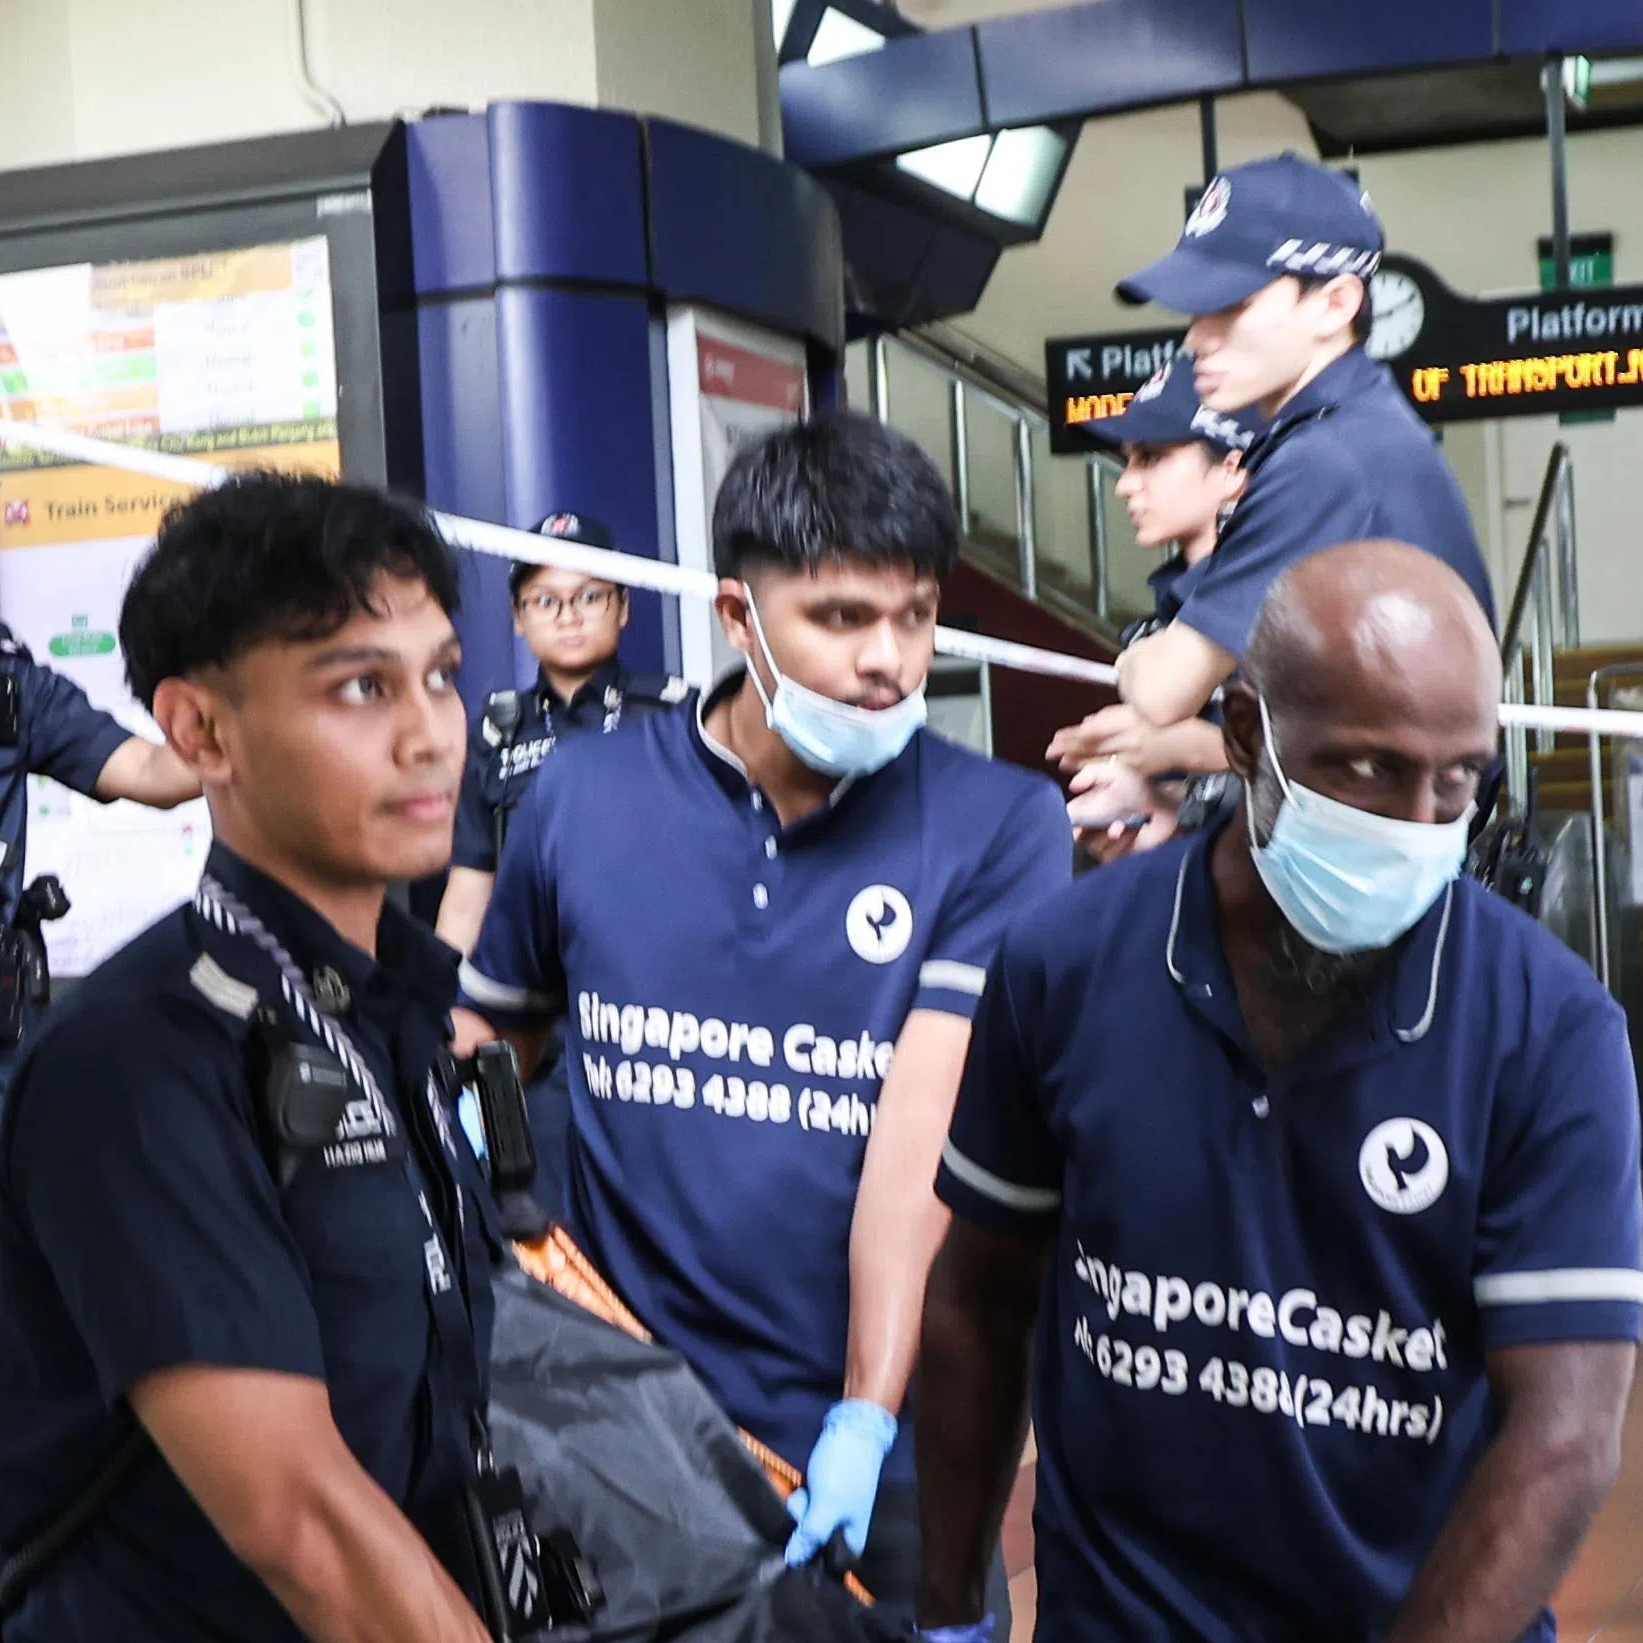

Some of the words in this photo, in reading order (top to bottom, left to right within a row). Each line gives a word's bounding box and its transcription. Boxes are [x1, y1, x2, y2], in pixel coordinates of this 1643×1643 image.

[1101, 338, 1197, 382] Platf
[1412, 366, 1451, 402] OF
[46, 493, 98, 522] Train
[578, 990, 775, 1067] Singapore
[783, 1022, 894, 1081] Caske
[615, 1060, 696, 1109] 6293
[701, 1073, 791, 1124] 4388
[797, 1086, 877, 1137] (24h
[1096, 1333, 1189, 1396] 6293
[1293, 1373, 1443, 1446] (24hrs)
